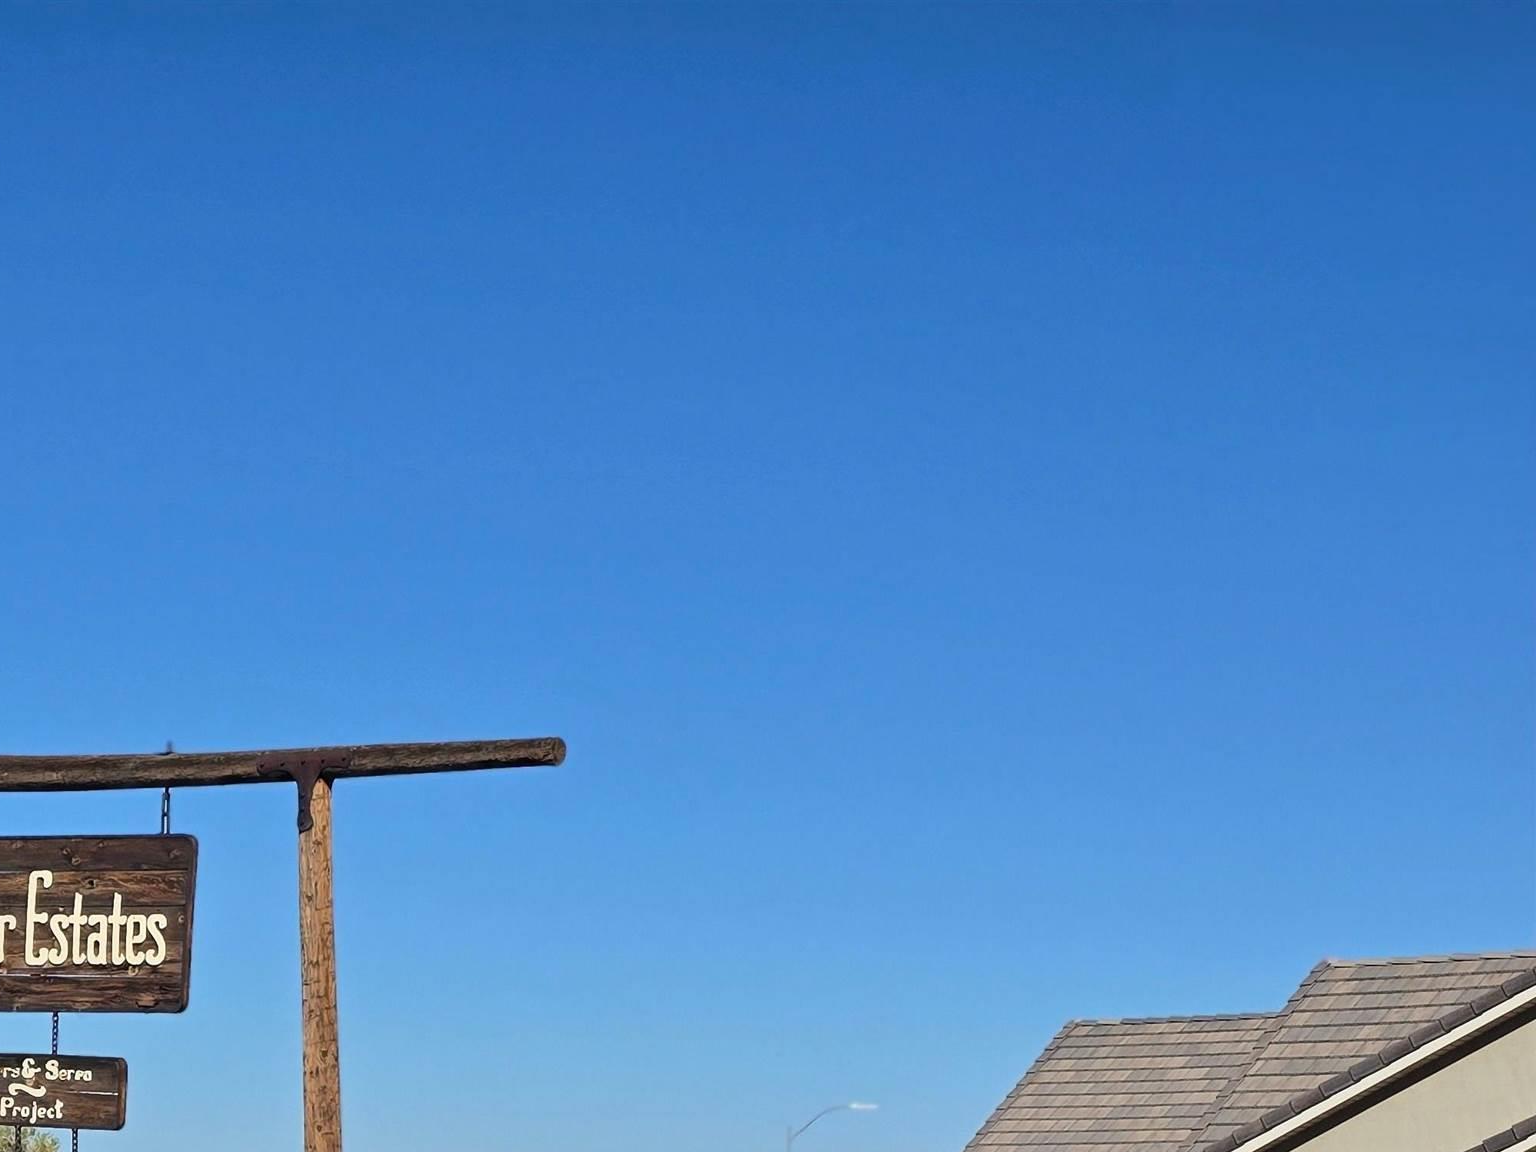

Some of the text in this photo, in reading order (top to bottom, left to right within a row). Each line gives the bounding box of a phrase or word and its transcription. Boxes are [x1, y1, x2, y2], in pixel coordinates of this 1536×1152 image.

[25, 869, 168, 967] Estates
[21, 1058, 41, 1079] &
[0, 1096, 64, 1124] Project
